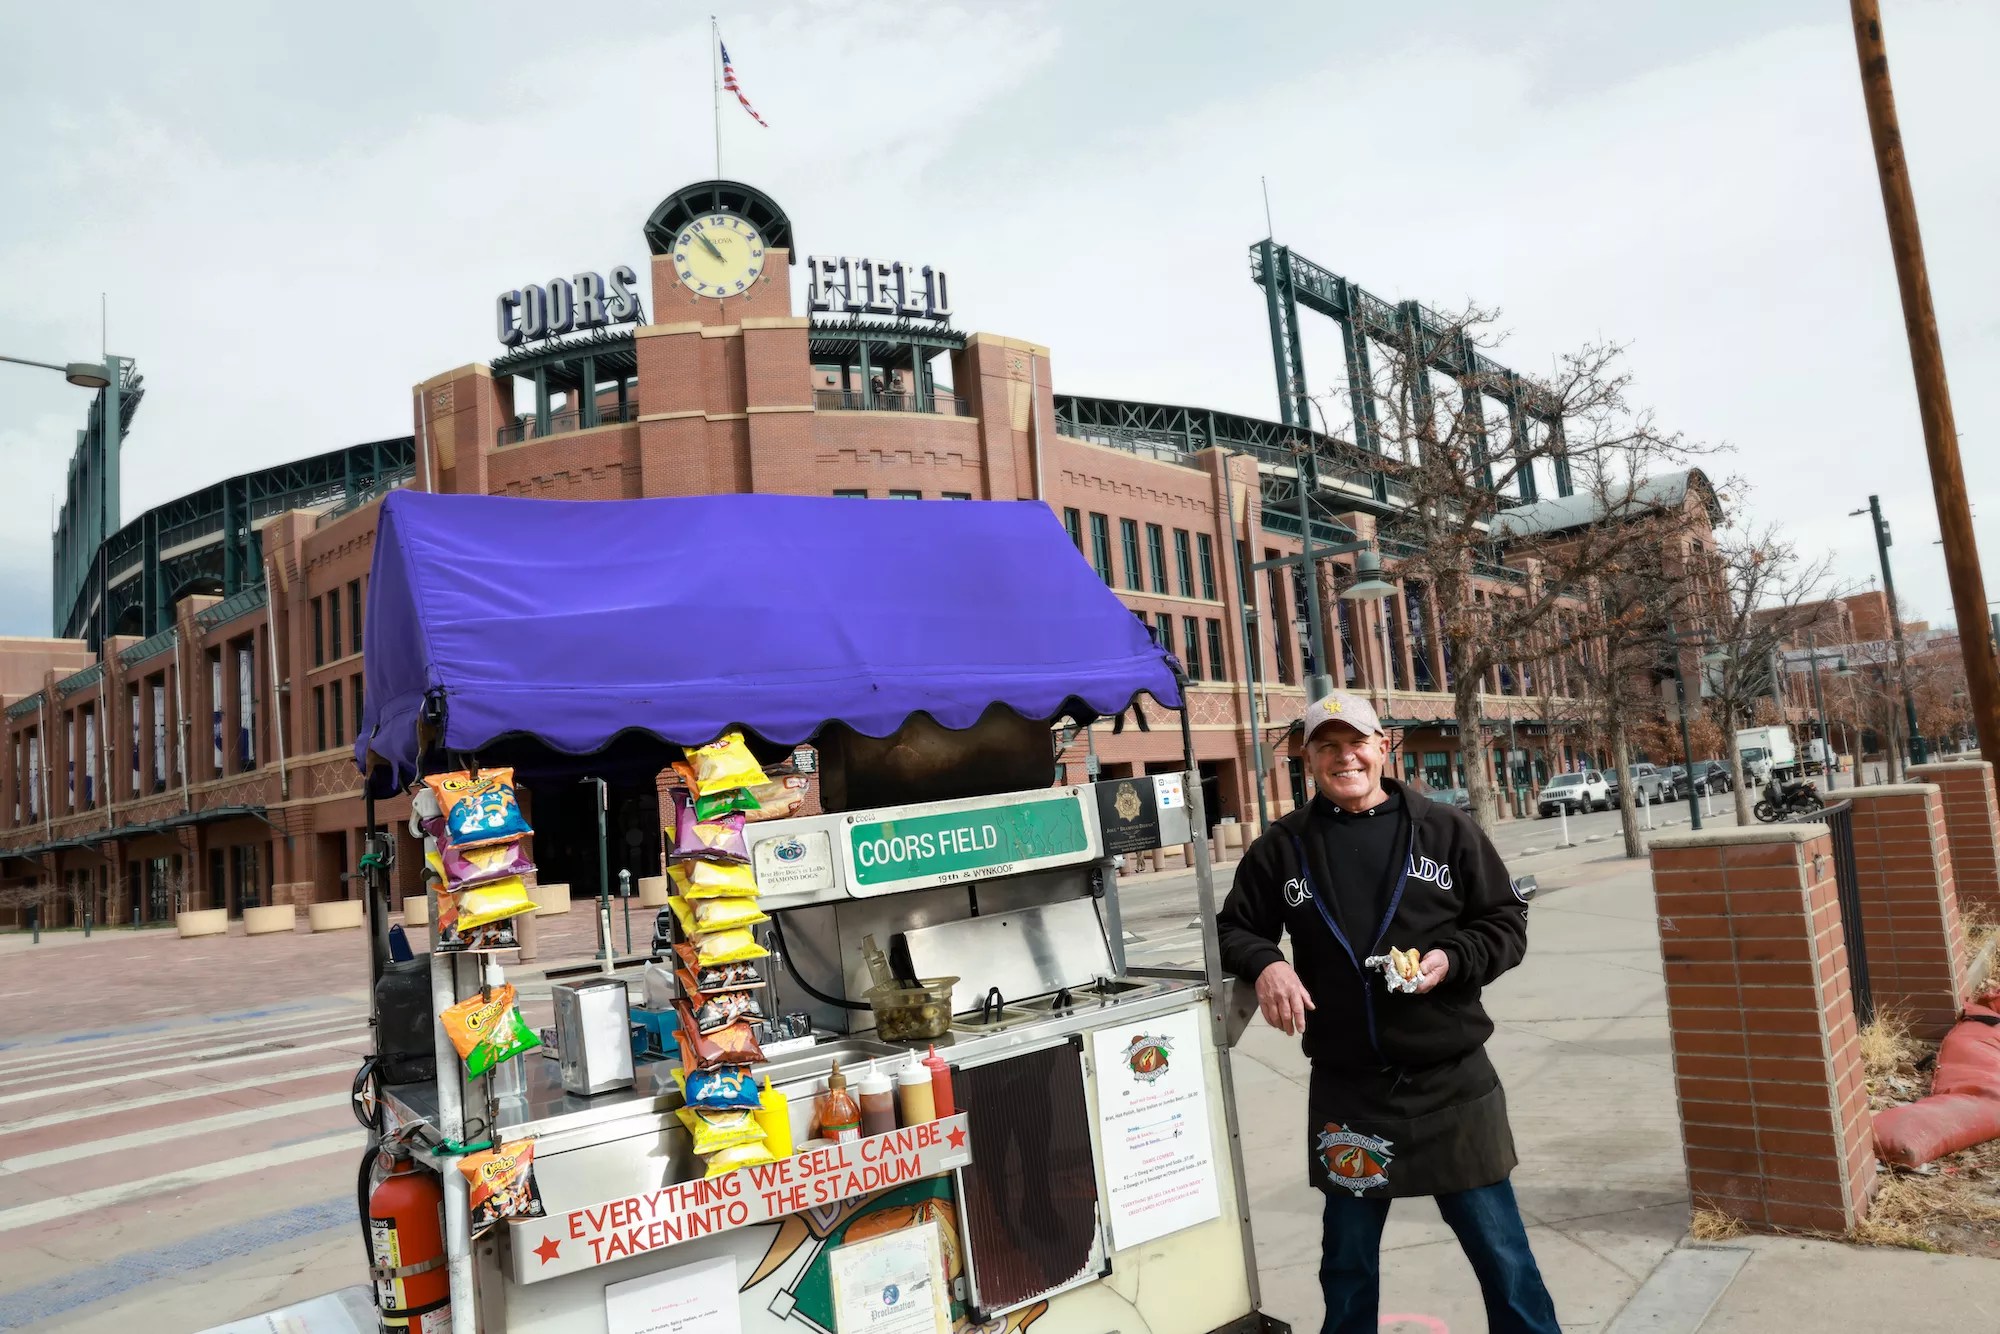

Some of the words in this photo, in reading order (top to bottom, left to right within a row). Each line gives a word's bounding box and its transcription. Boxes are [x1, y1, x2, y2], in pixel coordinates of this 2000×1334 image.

[710, 217, 725, 226] 12
[733, 220, 740, 229] 1
[691, 222, 704, 232] 11
[678, 233, 691, 246] 10
[746, 232, 756, 241] 2
[676, 253, 685, 262] 9
[752, 249, 762, 258] 3
[681, 270, 692, 280] 8
[748, 267, 758, 277] 4
[697, 282, 707, 291] 7
[735, 280, 745, 290] 5
[716, 286, 726, 295] 6
[497, 265, 637, 347] COORS
[808, 255, 952, 320] FIELD
[858, 832, 936, 867] COORS
[938, 824, 998, 855] FIELD
[767, 875, 799, 884] DIAMOND
[938, 872, 959, 883] 19th
[963, 870, 971, 878] &
[1324, 1133, 1379, 1152] DIAMOND
[568, 1171, 742, 1240] EVERYTHING
[748, 1155, 794, 1191] WE
[798, 1146, 852, 1179] SELL
[861, 1128, 912, 1163] CAN
[916, 1122, 943, 1149] BE
[1336, 1175, 1379, 1189] DAWGS
[588, 1218, 689, 1264] TAKEN
[688, 1200, 749, 1239] INTO
[762, 1187, 809, 1217] THE
[813, 1154, 922, 1203] STADIUM
[871, 1300, 916, 1322] Proclamation
